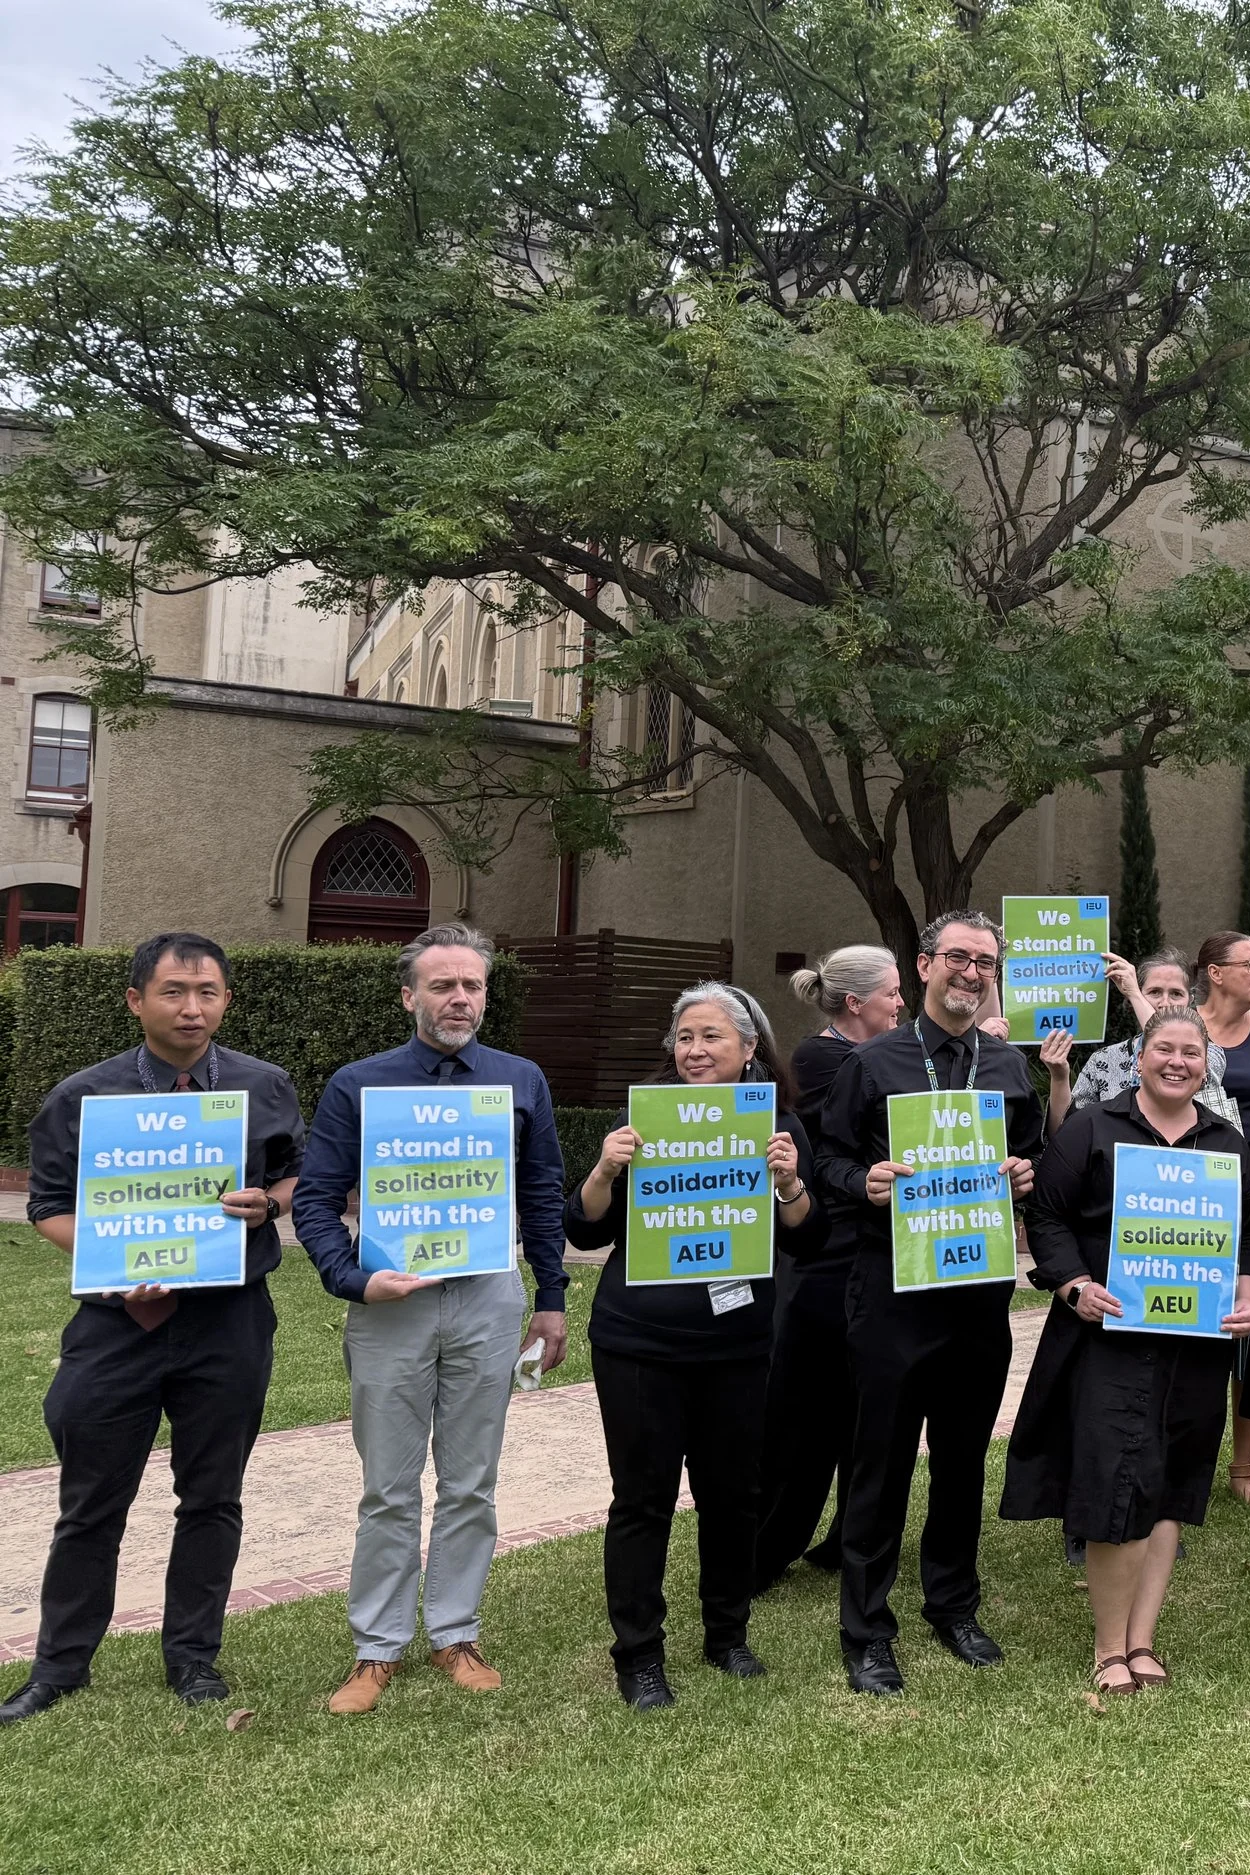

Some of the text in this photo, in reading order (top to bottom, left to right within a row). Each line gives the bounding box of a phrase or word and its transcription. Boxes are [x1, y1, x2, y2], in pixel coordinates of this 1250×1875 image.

[1086, 902, 1102, 910] IEU
[1037, 910, 1071, 926] We
[1012, 934, 1095, 952] stand in
[1012, 960, 1100, 979] solidarity
[1014, 986, 1097, 1003] with the
[1039, 1014, 1074, 1030] AEU
[212, 1100, 236, 1110] IEU
[481, 1096, 502, 1104] IEU
[745, 1091, 767, 1101] IEU
[985, 1099, 999, 1108] IEU
[136, 1112, 187, 1132] We
[412, 1104, 459, 1124] We
[677, 1103, 723, 1123] We
[932, 1108, 972, 1129] We
[94, 1142, 223, 1168] stand in
[375, 1135, 493, 1158] stand in
[641, 1134, 756, 1159] stand in
[902, 1139, 996, 1165] stand in
[1156, 1163, 1195, 1184] We
[1213, 1161, 1232, 1171] IEU
[92, 1176, 230, 1206] solidarity
[374, 1168, 499, 1194] solidarity
[640, 1167, 761, 1196] solidarity
[903, 1171, 1001, 1201] solidarity
[376, 1204, 495, 1227] with the
[1125, 1192, 1224, 1218] stand in
[94, 1213, 225, 1238] with the
[642, 1204, 758, 1229] with the
[907, 1207, 1004, 1234] with the
[411, 1239, 461, 1262] AEU
[1122, 1226, 1228, 1253] solidarity
[133, 1247, 188, 1269] AEU
[676, 1241, 724, 1263] AEU
[942, 1243, 981, 1267] AEU
[1122, 1255, 1223, 1284] with the
[1149, 1295, 1192, 1314] AEU
